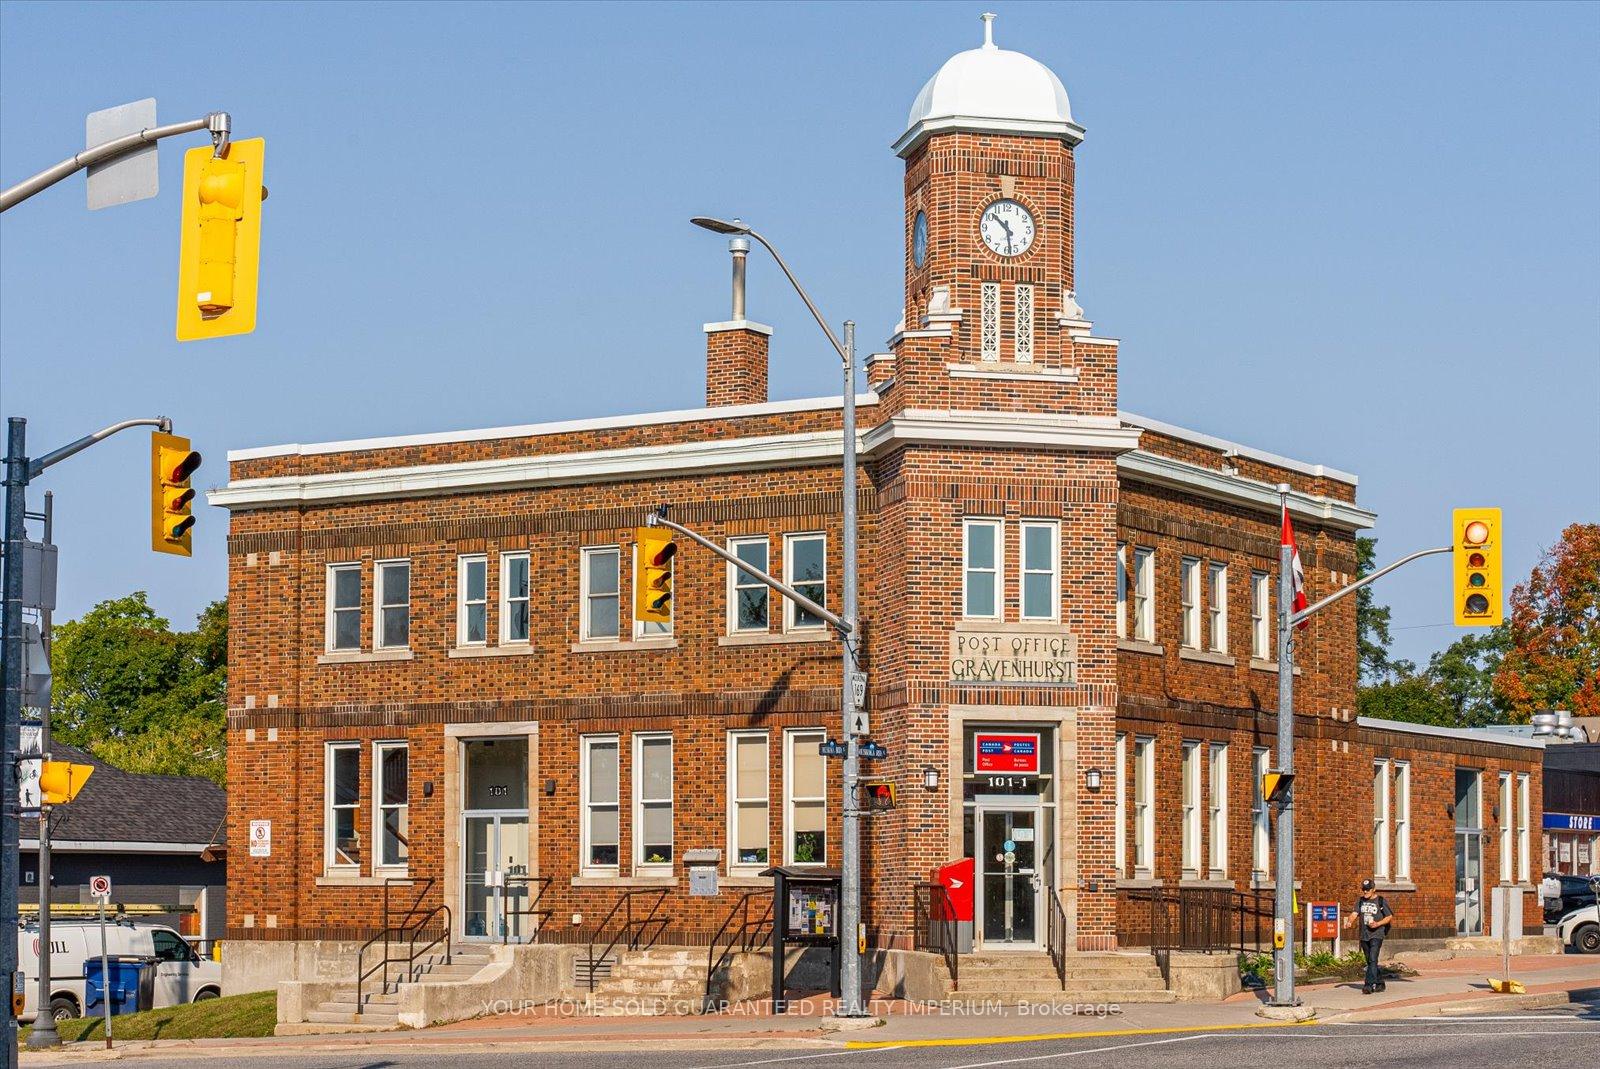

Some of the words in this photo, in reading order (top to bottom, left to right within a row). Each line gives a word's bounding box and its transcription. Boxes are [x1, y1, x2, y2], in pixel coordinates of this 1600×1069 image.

[995, 205, 1000, 214] 11
[1003, 204, 1012, 212] 12
[985, 213, 993, 221] 10
[1022, 215, 1027, 223] 2
[982, 223, 987, 232] 9
[1026, 226, 1031, 234] 3
[986, 235, 991, 243] 8
[1020, 237, 1026, 245] 4
[995, 243, 1000, 251] 7
[1013, 245, 1018, 253] 5
[958, 636, 1001, 651] POST
[1011, 637, 1071, 652] OFFICE
[952, 660, 1075, 678] GRAVENHURST
[854, 684, 863, 697] 169
[988, 777, 1027, 787] 101-1
[489, 786, 508, 796] 101
[1569, 815, 1593, 829] STORE
